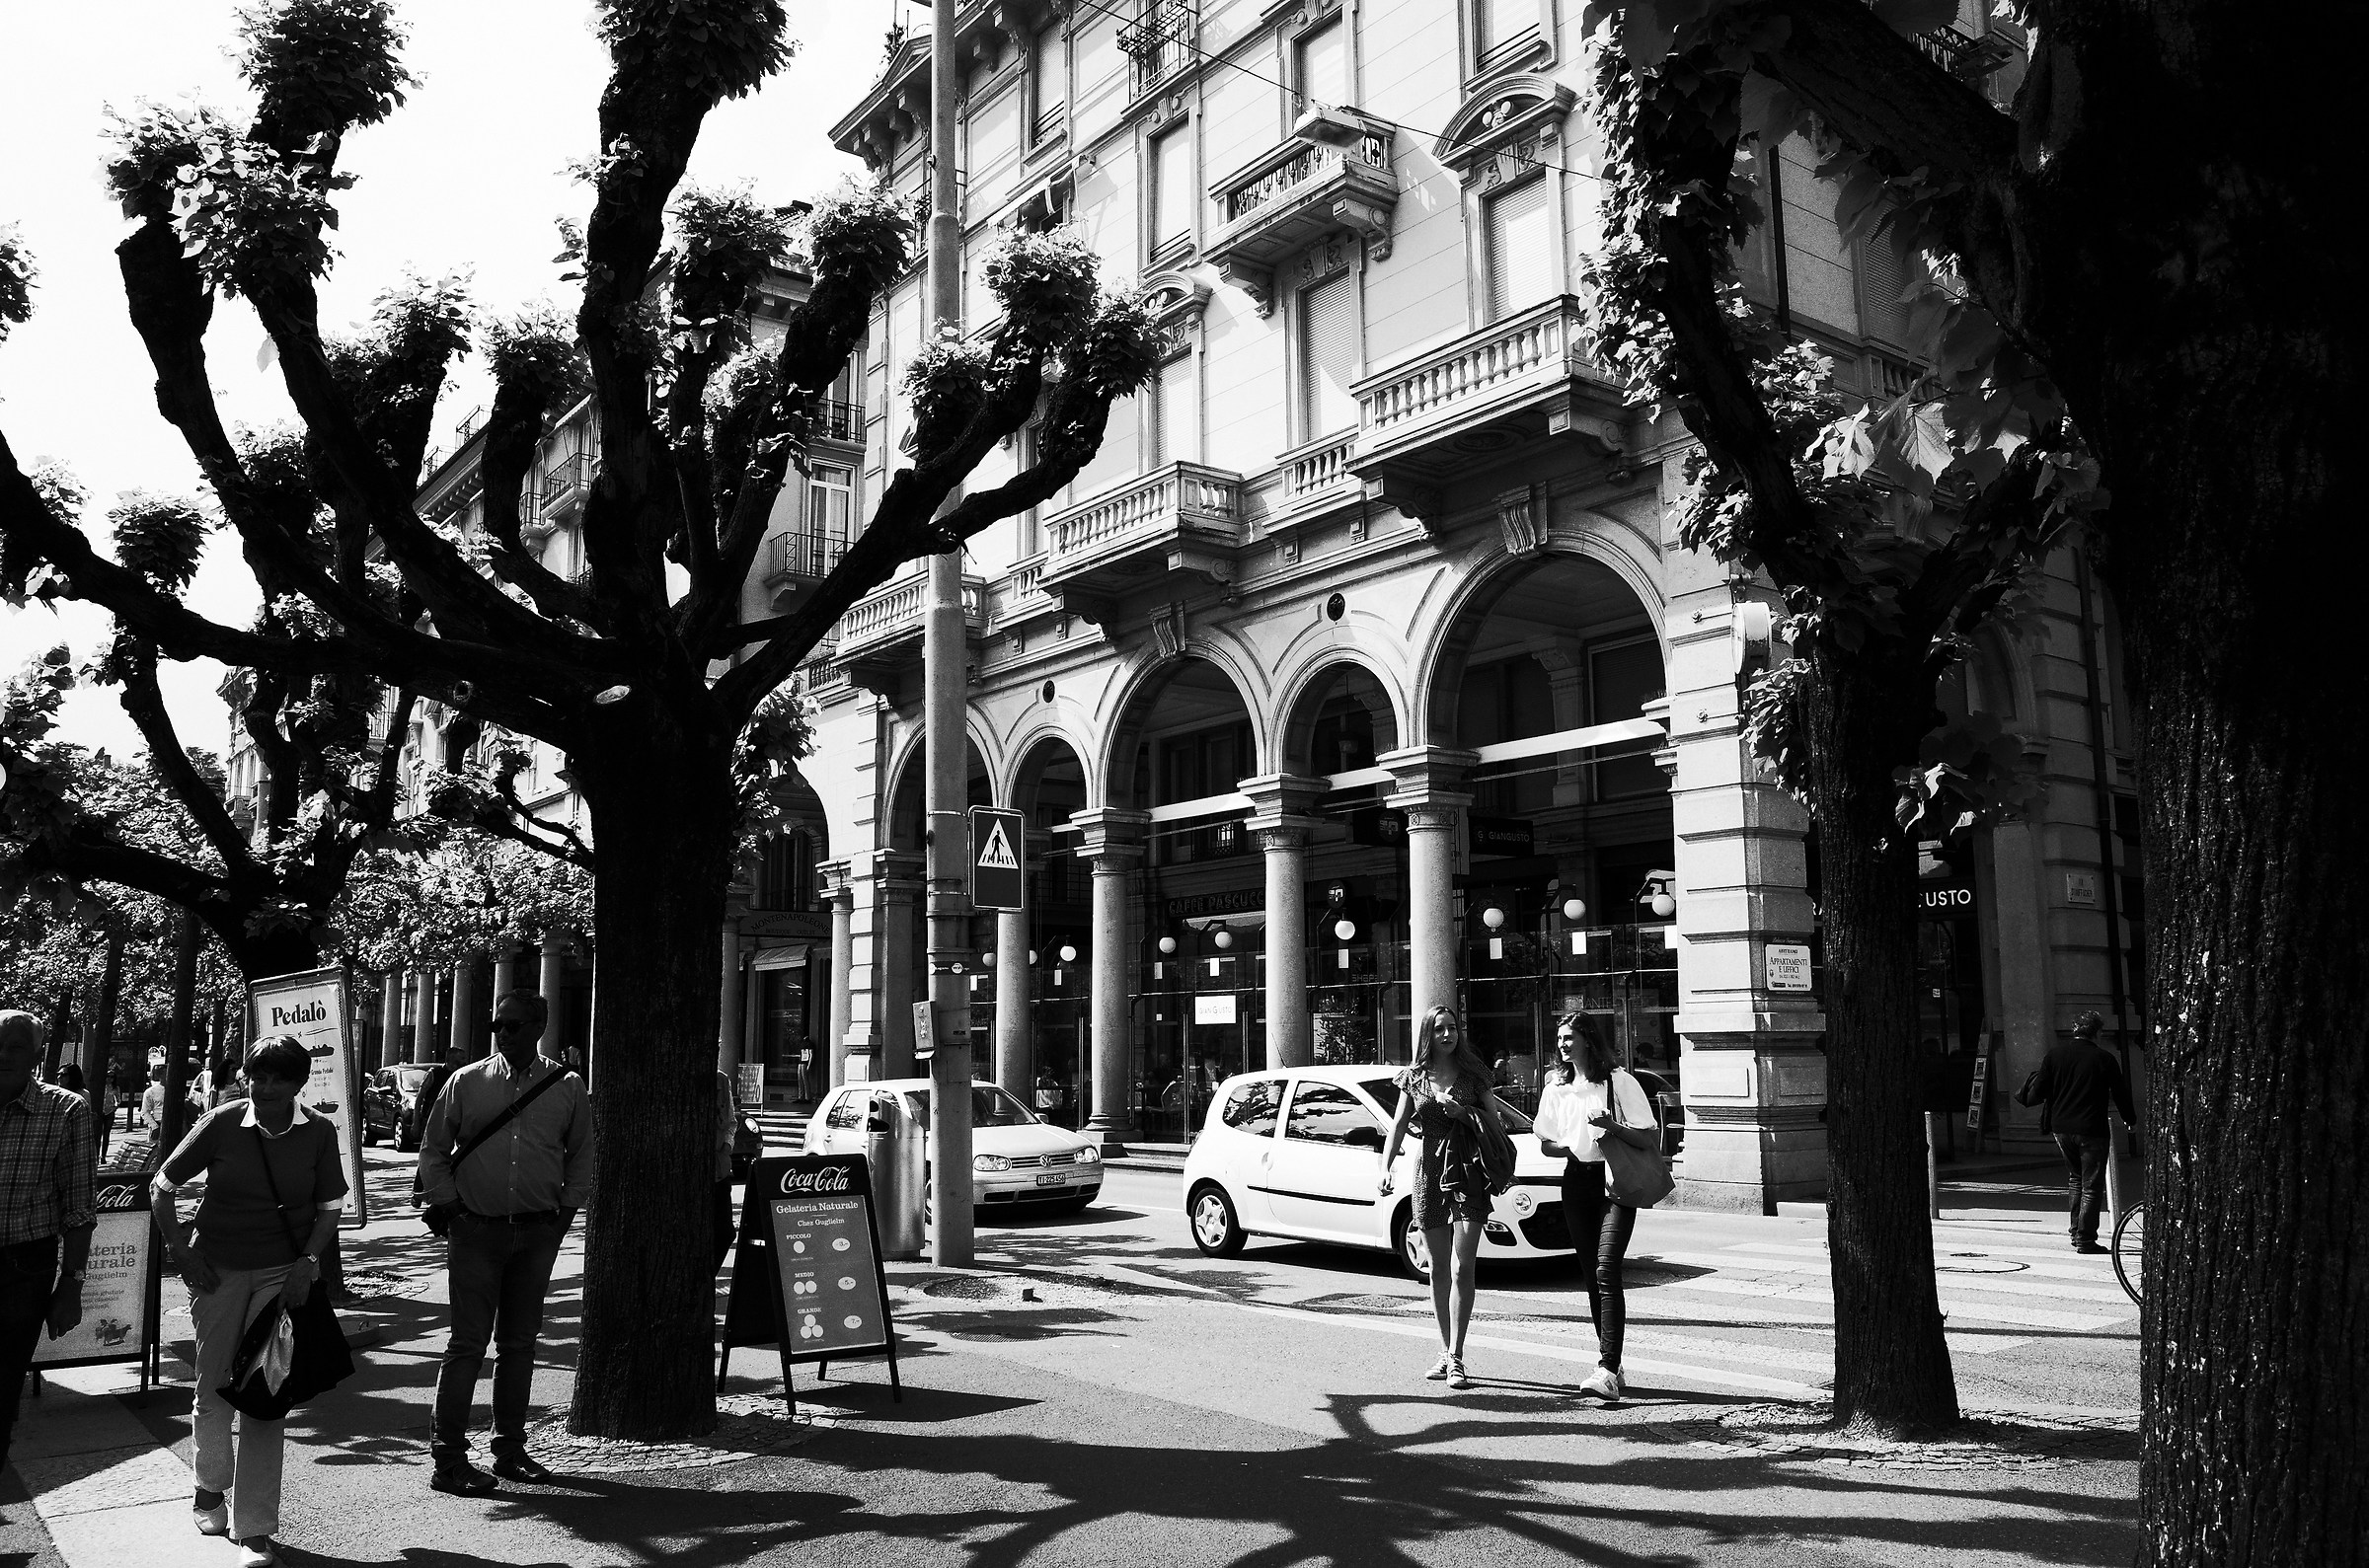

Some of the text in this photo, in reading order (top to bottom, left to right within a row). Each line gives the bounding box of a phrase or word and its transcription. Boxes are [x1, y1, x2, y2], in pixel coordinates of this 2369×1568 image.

[1489, 831, 1530, 843] GIANGUSTO
[1208, 890, 1265, 909] PASCUCC
[1918, 888, 1971, 907] USTO
[750, 913, 831, 934] MONTENAPOLEONE
[1769, 956, 1807, 966] APPARTAMENTI
[271, 1000, 327, 1027] Pedalò
[97, 1184, 140, 1209] Cola
[776, 1201, 859, 1214] Gelateria Naturale
[89, 1242, 137, 1257] teria
[87, 1255, 136, 1270] urale
